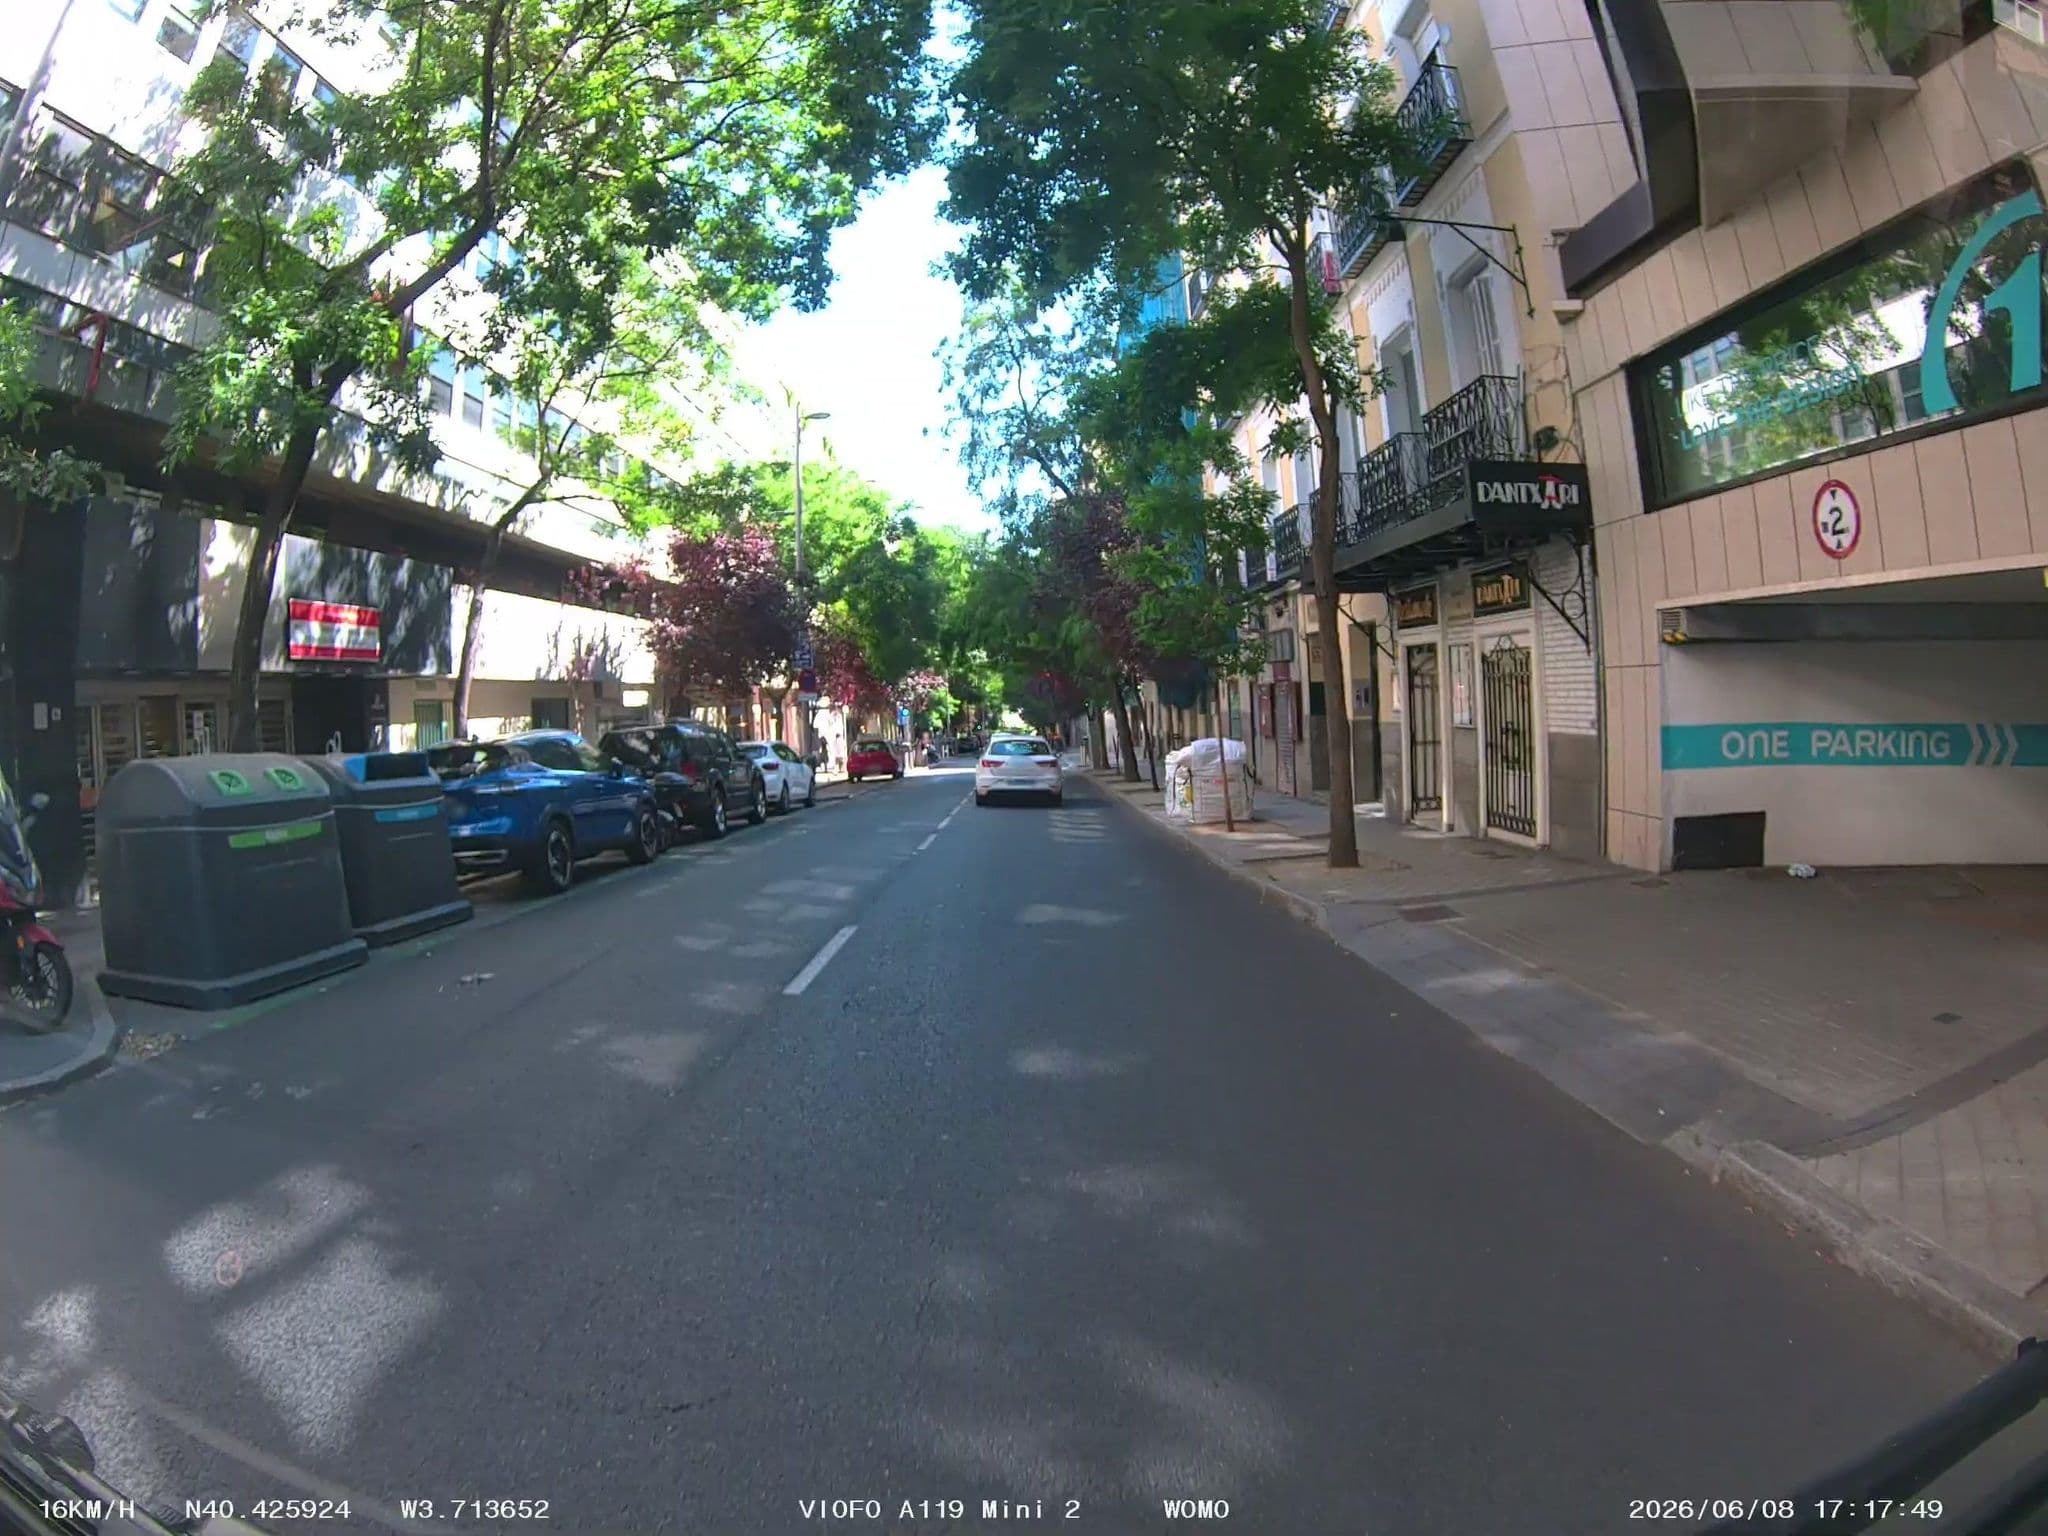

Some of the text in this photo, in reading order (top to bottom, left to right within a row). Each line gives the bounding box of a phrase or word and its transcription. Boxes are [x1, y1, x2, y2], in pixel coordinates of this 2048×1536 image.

[1681, 413, 1730, 451] LOVE
[1477, 474, 1580, 510] DANTXARI
[1721, 730, 1950, 759] ONE PARKING
